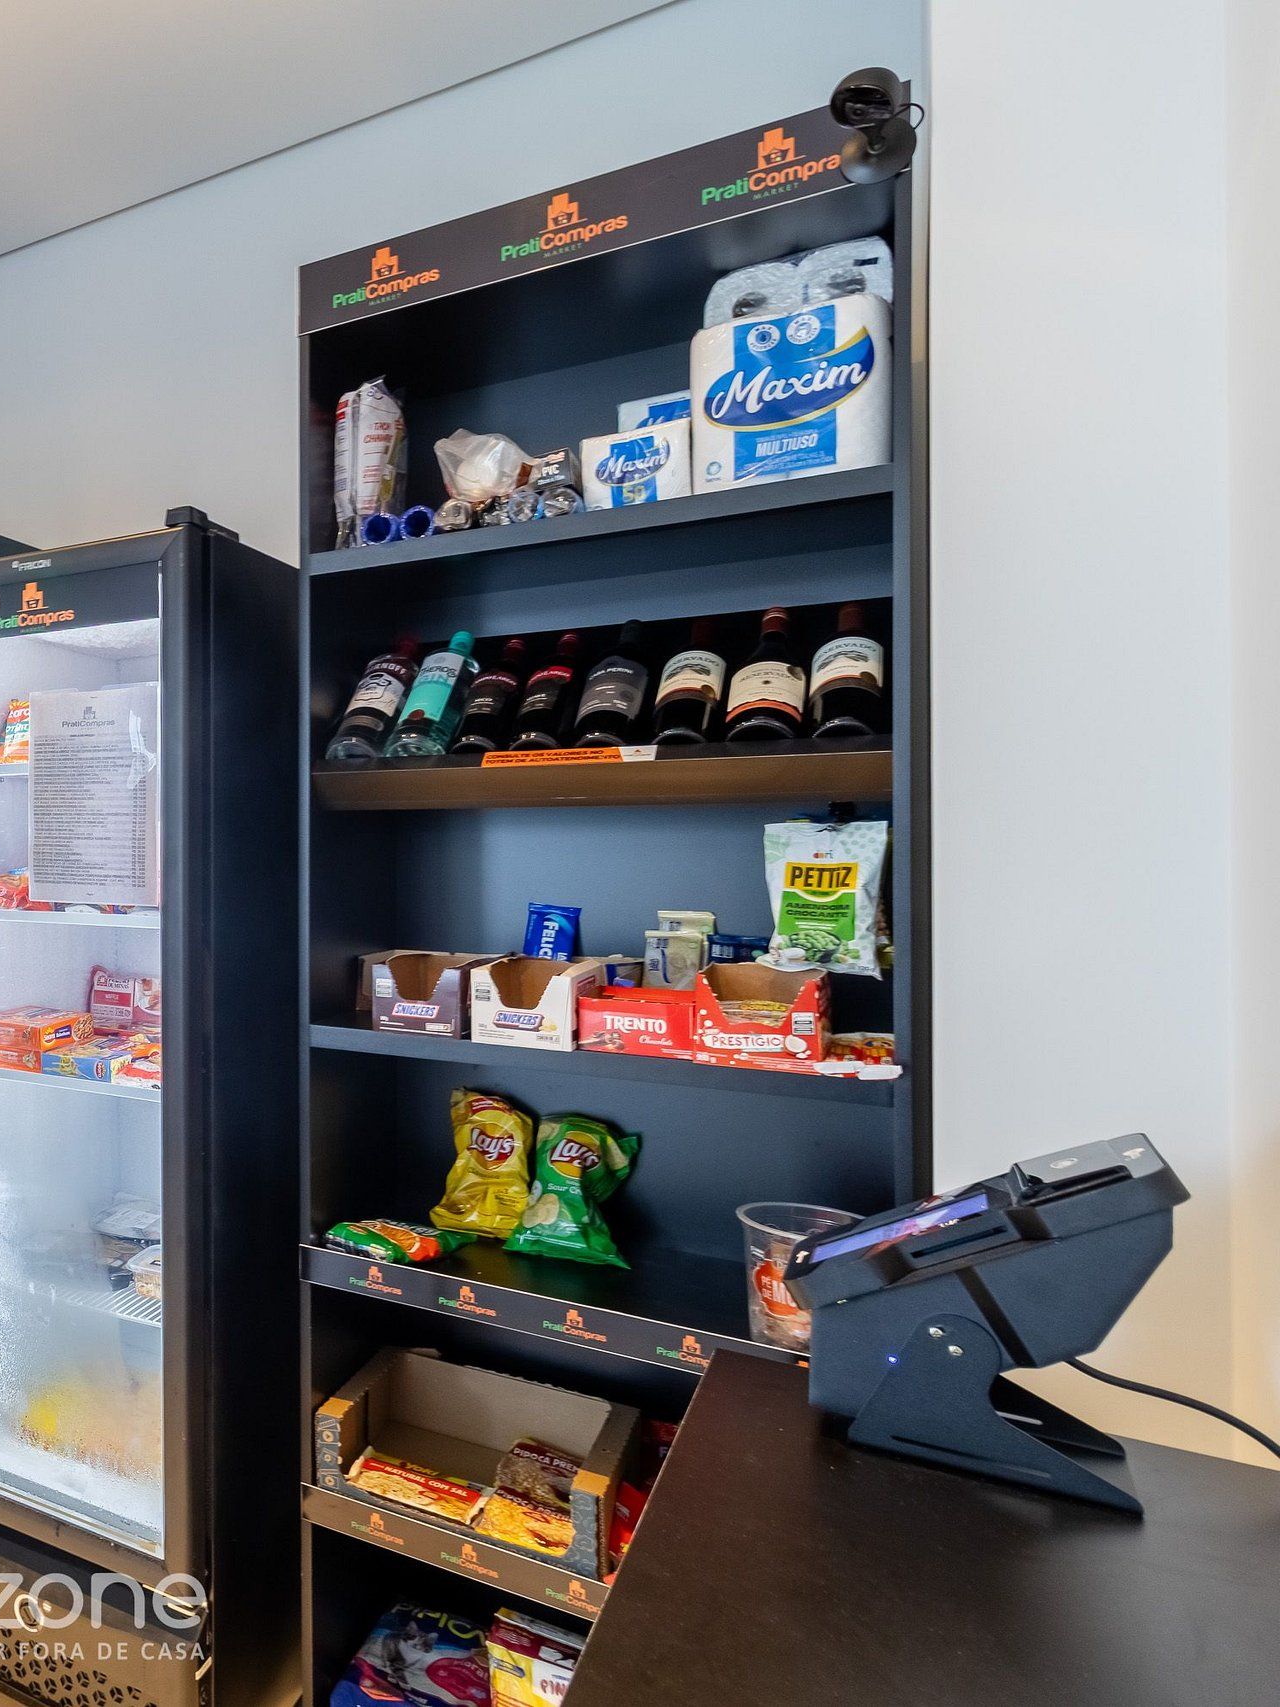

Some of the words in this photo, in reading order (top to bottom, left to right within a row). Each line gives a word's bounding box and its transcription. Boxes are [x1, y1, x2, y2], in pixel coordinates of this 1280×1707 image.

[701, 153, 843, 206] PratiCompra
[752, 182, 800, 201] MARKET
[500, 214, 629, 262] PratiCompras
[542, 242, 584, 259] MARKET
[332, 268, 441, 308] PratiCompras
[711, 361, 867, 419] Maxim
[755, 432, 819, 458] MULTIUSO
[599, 447, 667, 479] Maxim
[61, 719, 115, 728] PratiCompras
[789, 866, 853, 889] PETTIZ
[784, 902, 850, 910] AMENDOIM
[785, 909, 849, 918] CROCANTE
[538, 921, 560, 959] FELICI
[394, 1003, 436, 1017] SNICKERS
[495, 1012, 539, 1026] SNICKERS
[603, 1014, 667, 1034] TRENTO
[470, 1128, 515, 1160] Lay's
[547, 1182, 568, 1192] Sour
[349, 1276, 403, 1296] PratiCompras
[438, 1295, 497, 1318] PratiCompras
[542, 1320, 607, 1343] PratiCompras
[513, 1447, 550, 1465] PIPOCA
[383, 1465, 426, 1484] NATURAL
[427, 1478, 448, 1491] COM
[450, 1486, 469, 1498] SAL
[350, 1520, 405, 1546] PratiCompras
[440, 1551, 500, 1579] PratiCompras
